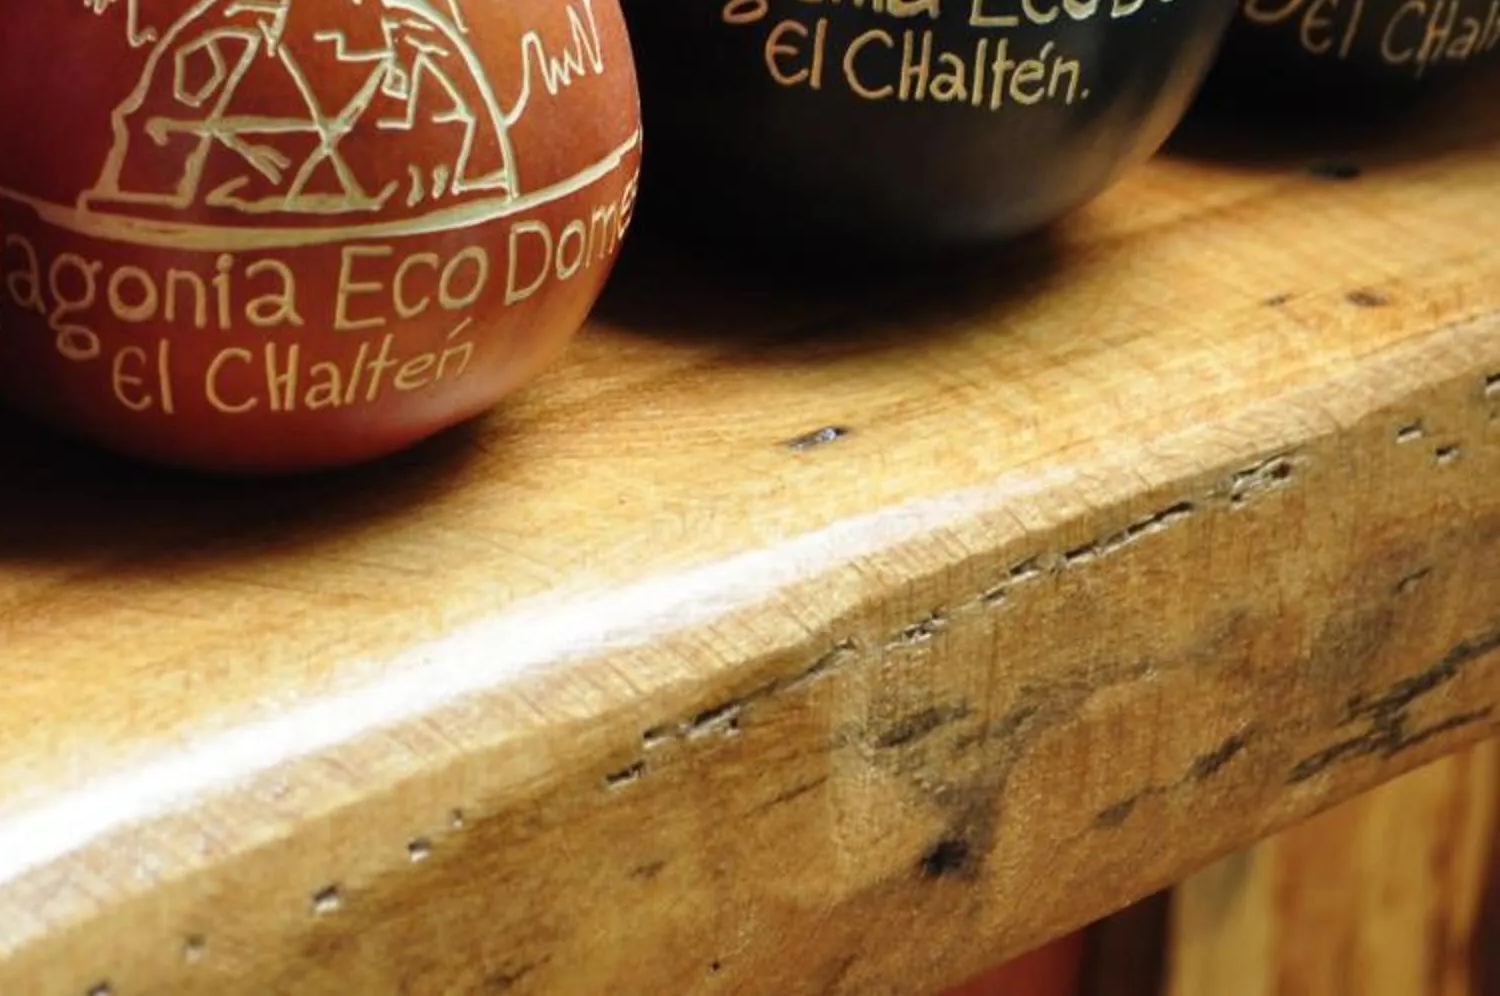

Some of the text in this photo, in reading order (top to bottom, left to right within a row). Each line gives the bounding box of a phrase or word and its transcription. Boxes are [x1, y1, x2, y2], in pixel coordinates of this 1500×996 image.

[764, 17, 828, 91] El
[333, 240, 491, 331] Eco
[112, 338, 175, 415] El
